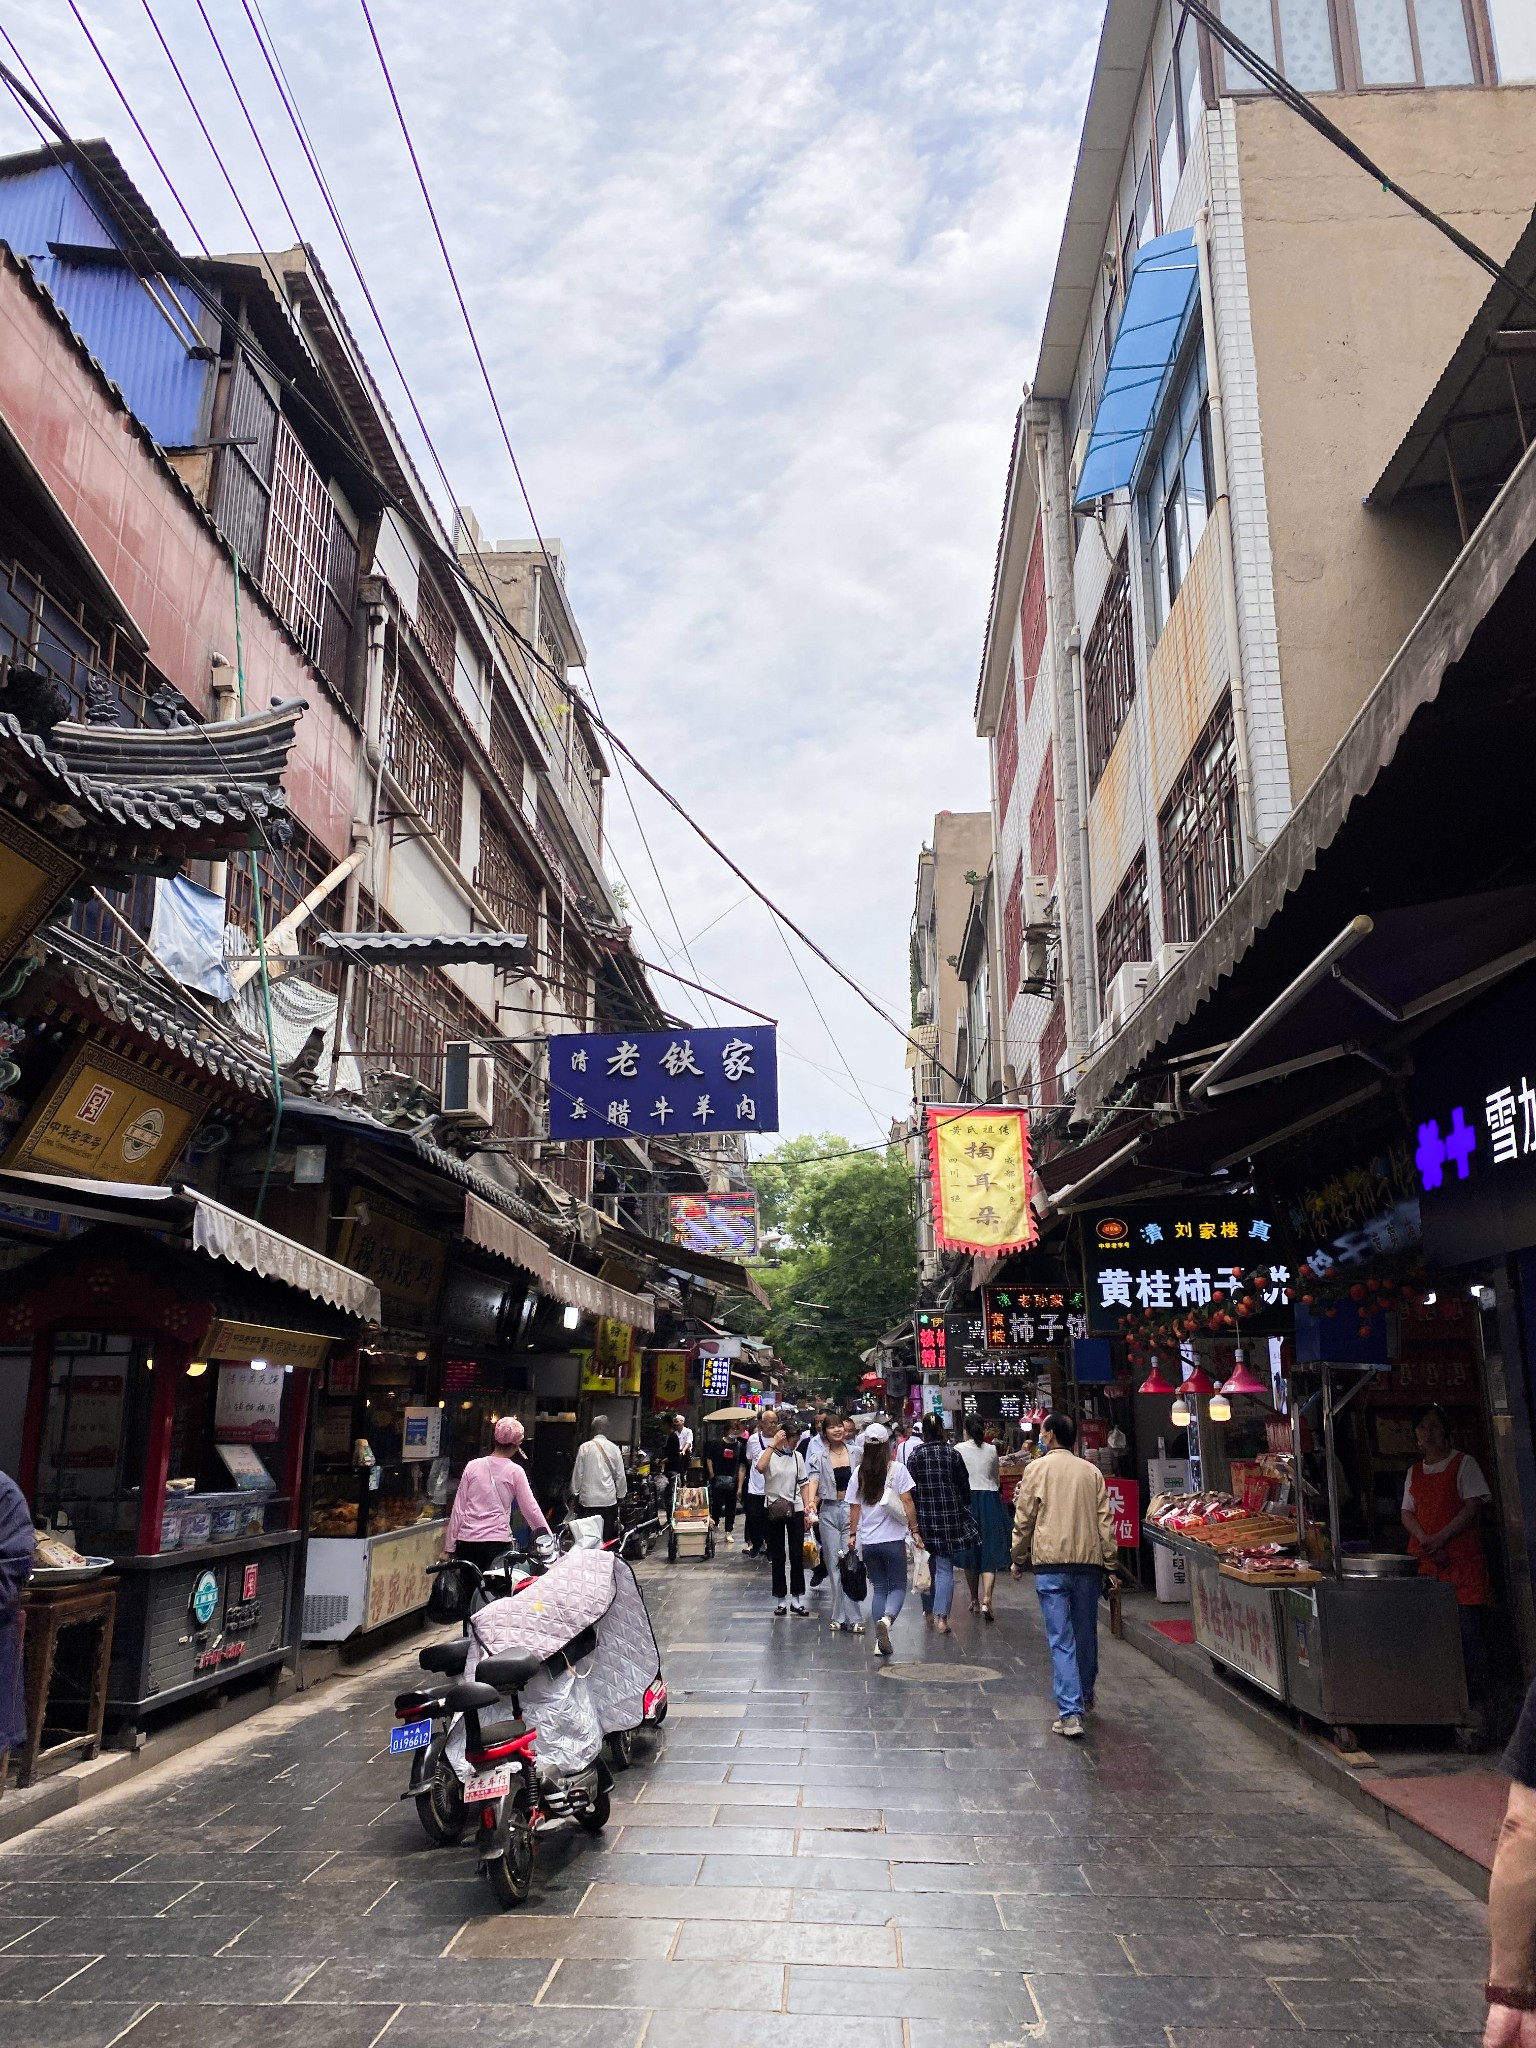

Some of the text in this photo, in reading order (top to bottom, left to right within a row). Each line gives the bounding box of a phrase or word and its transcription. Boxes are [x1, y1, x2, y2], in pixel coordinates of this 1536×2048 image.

[571, 1037, 756, 1082] 清 老铁家
[606, 1093, 756, 1127] 腊牛羊肉
[949, 1124, 1010, 1136] 黄氏祖传
[948, 1157, 962, 1204] 四川一绝
[964, 1141, 1001, 1226] 掏耳朵
[1003, 1155, 1018, 1206] 成都特色
[1174, 1221, 1240, 1241] 刘家楼
[1248, 1219, 1273, 1242] 真
[1008, 1312, 1089, 1343] 柿子饼
[664, 1361, 679, 1392] 冰粉
[393, 1733, 429, 1751] 0196612
